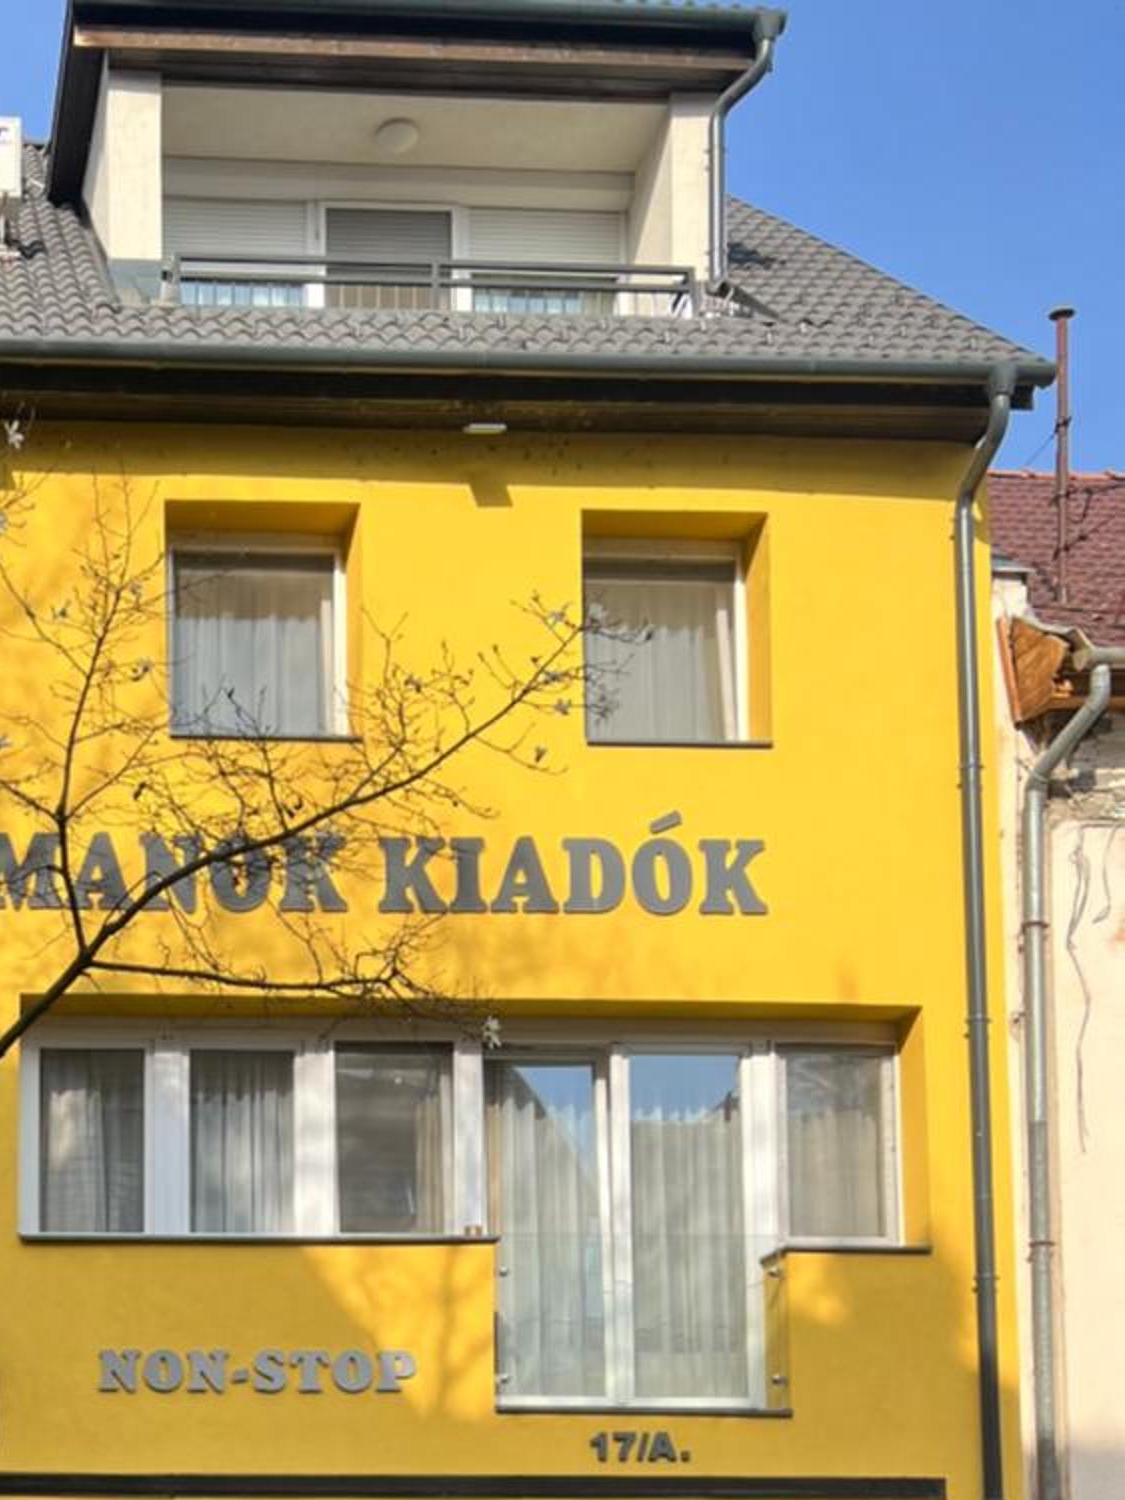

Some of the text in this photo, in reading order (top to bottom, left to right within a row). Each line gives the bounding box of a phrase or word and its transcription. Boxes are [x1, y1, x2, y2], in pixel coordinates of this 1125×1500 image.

[377, 811, 769, 916] KIADÓK
[98, 1349, 416, 1394] NON-STOP
[589, 1431, 691, 1463] 17/A.
